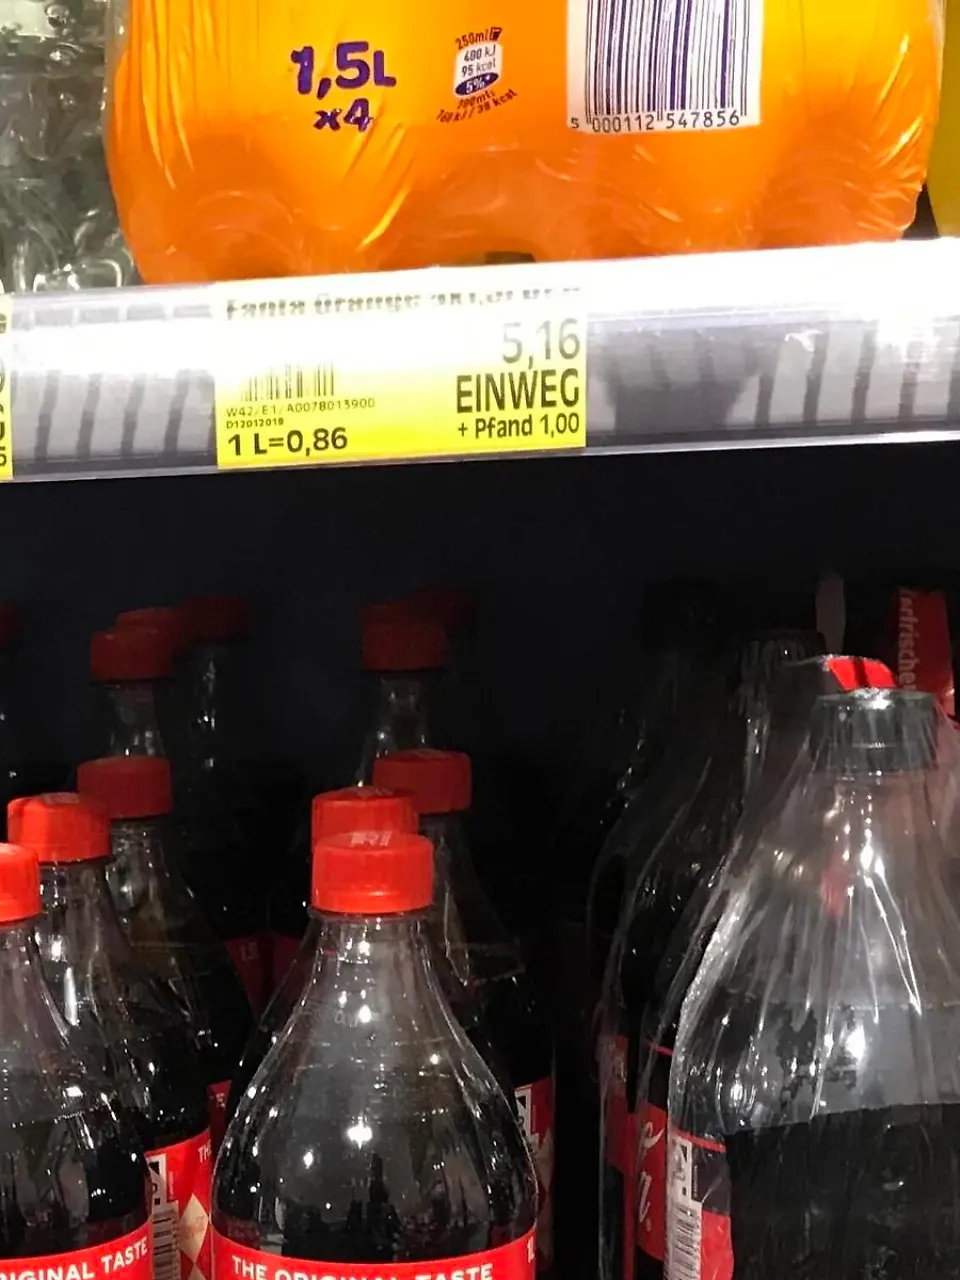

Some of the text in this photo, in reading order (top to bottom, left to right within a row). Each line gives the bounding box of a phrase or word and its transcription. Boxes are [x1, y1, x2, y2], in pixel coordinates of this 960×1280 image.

[290, 41, 397, 100] 1,5L
[313, 97, 373, 133] x4
[571, 110, 740, 132] 5 000112 547856
[502, 318, 581, 369] 5,16
[456, 368, 581, 414] EINWEG
[228, 426, 348, 458] 1 L=0,86
[458, 412, 580, 440] + Pfand 1,00
[101, 1237, 150, 1275] TASTE
